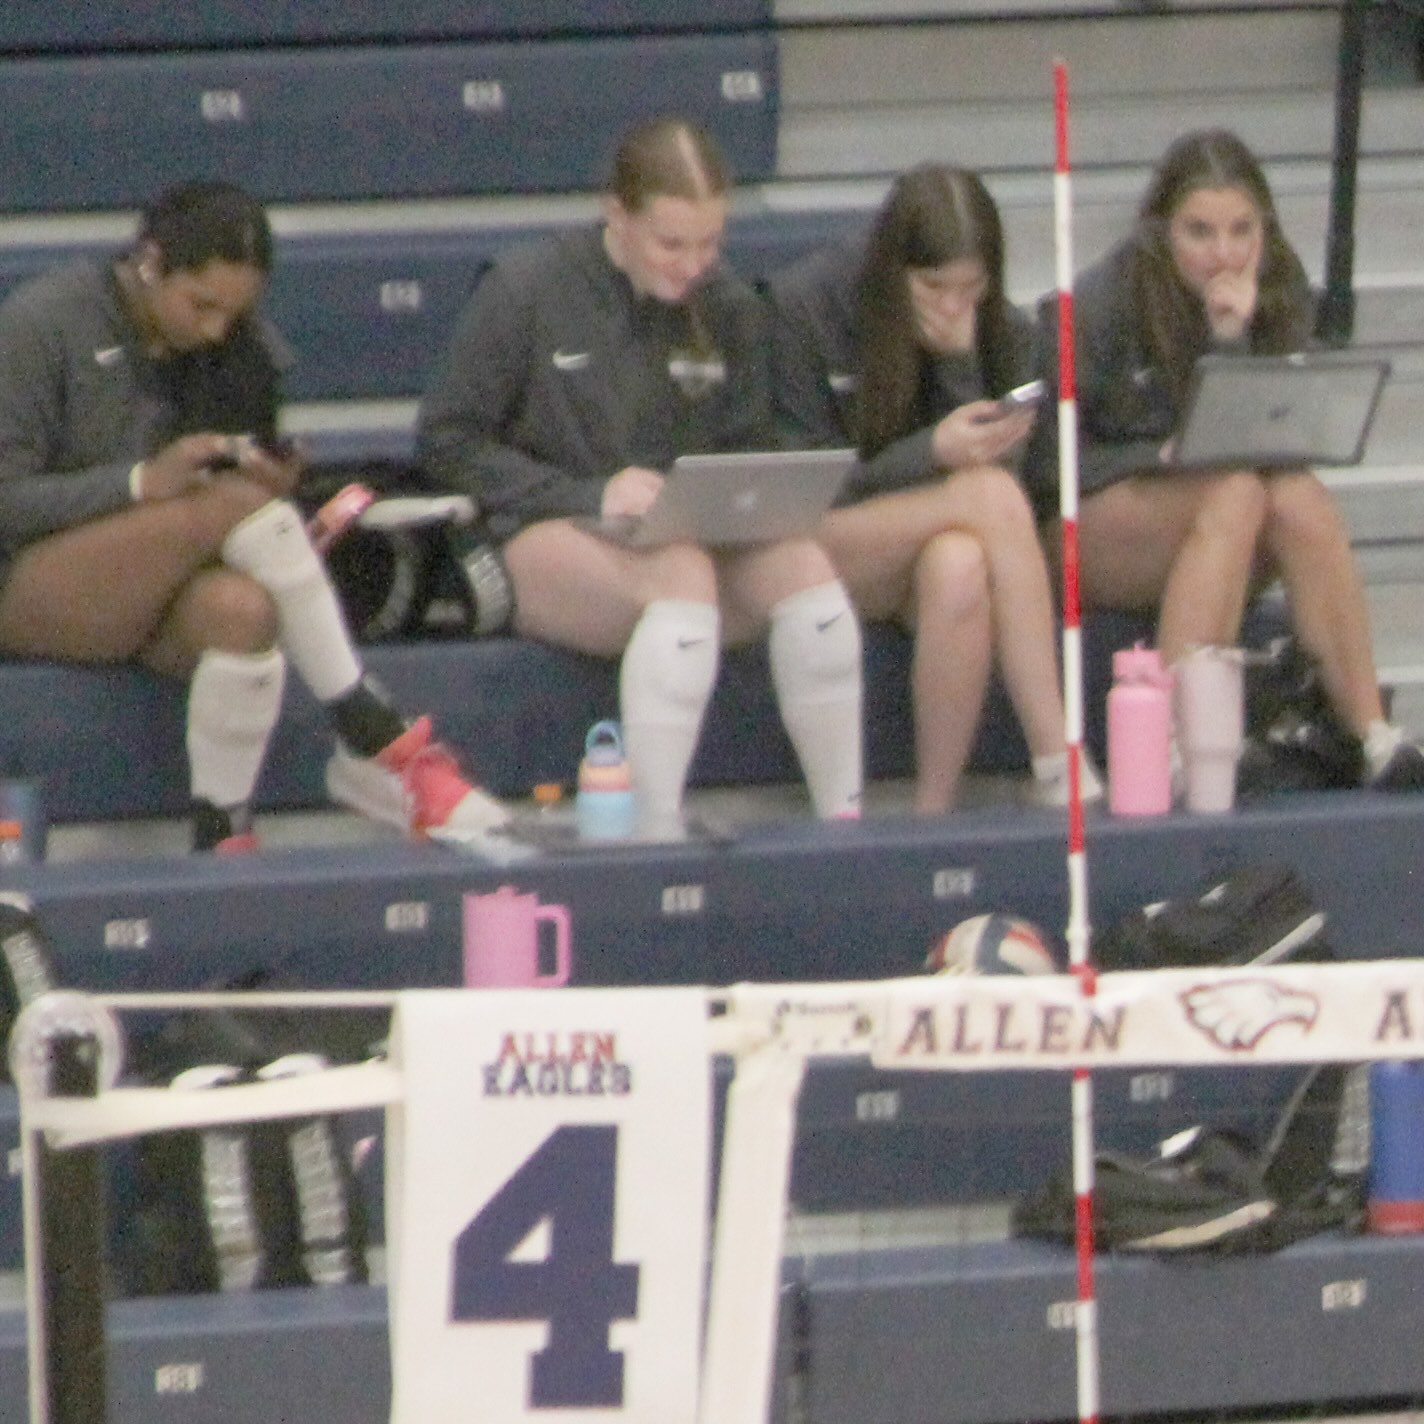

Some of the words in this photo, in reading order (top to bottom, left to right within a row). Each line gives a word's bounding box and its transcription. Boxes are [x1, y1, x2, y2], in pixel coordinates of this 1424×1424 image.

[496, 1033, 617, 1064] ALLEN
[897, 1002, 1127, 1055] ALLEN
[483, 1063, 632, 1097] EAGLES
[448, 1123, 640, 1409] 4
